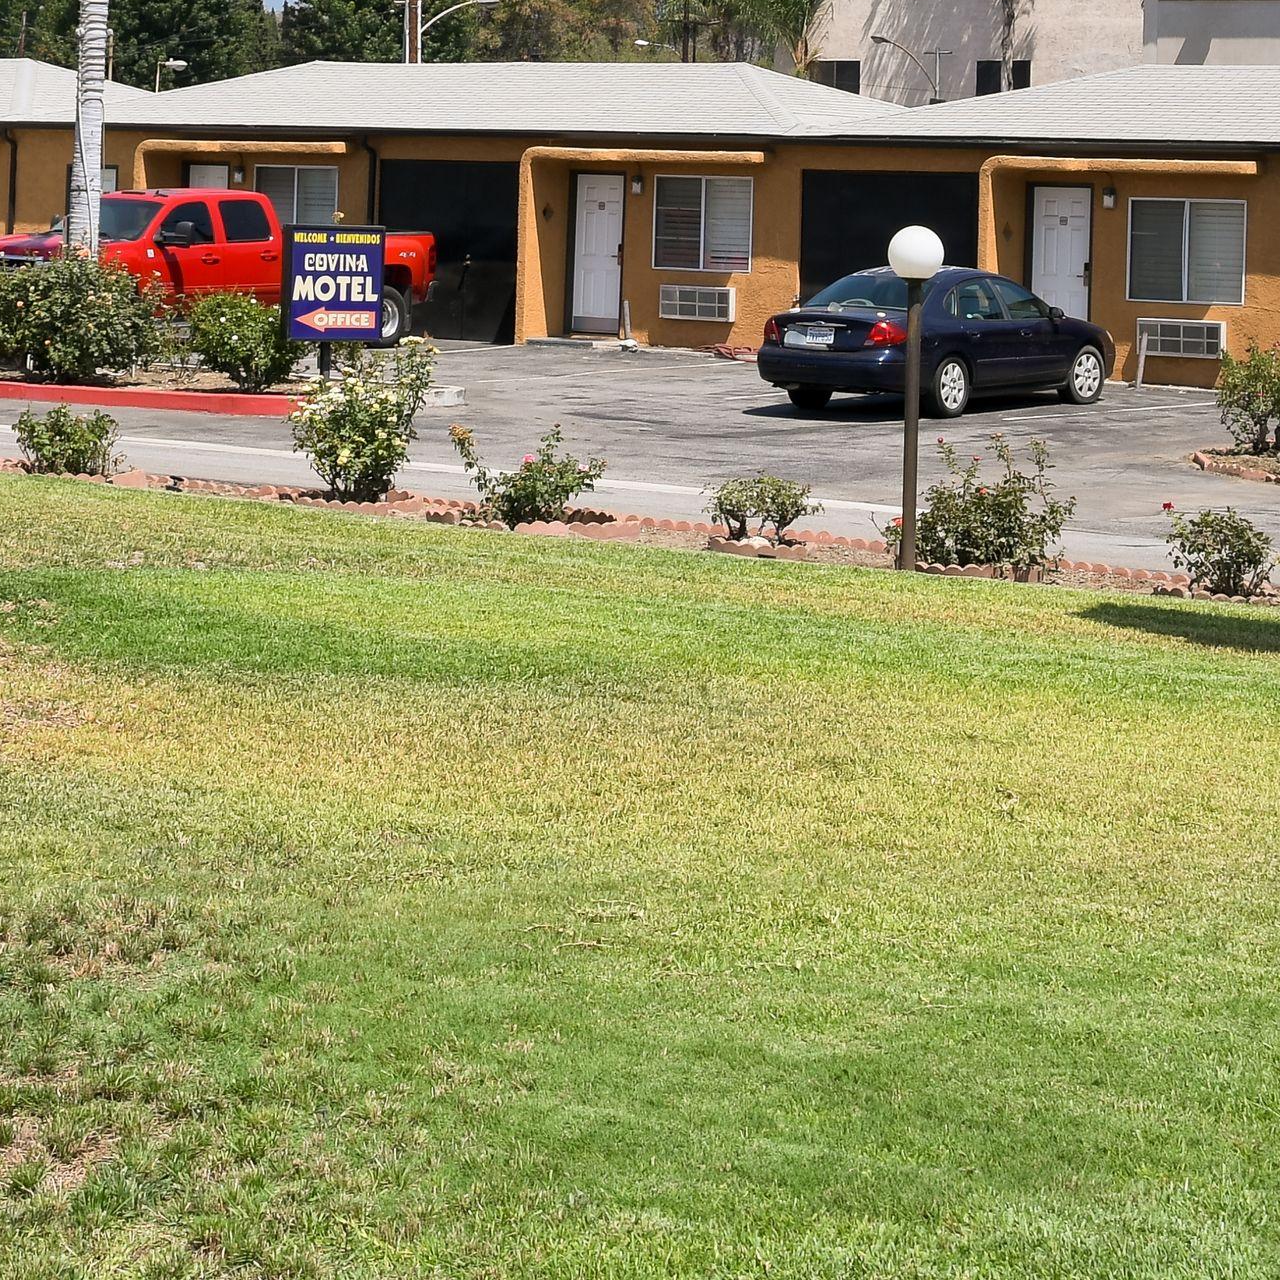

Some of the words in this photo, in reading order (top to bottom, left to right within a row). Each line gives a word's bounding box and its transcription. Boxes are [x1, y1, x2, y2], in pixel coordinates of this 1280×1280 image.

[294, 232, 327, 243] WELCOME
[335, 233, 380, 244] BIENVENIDOS
[304, 253, 369, 272] COVINA
[292, 275, 378, 302] MOTEL
[313, 313, 370, 326] OFFICE
